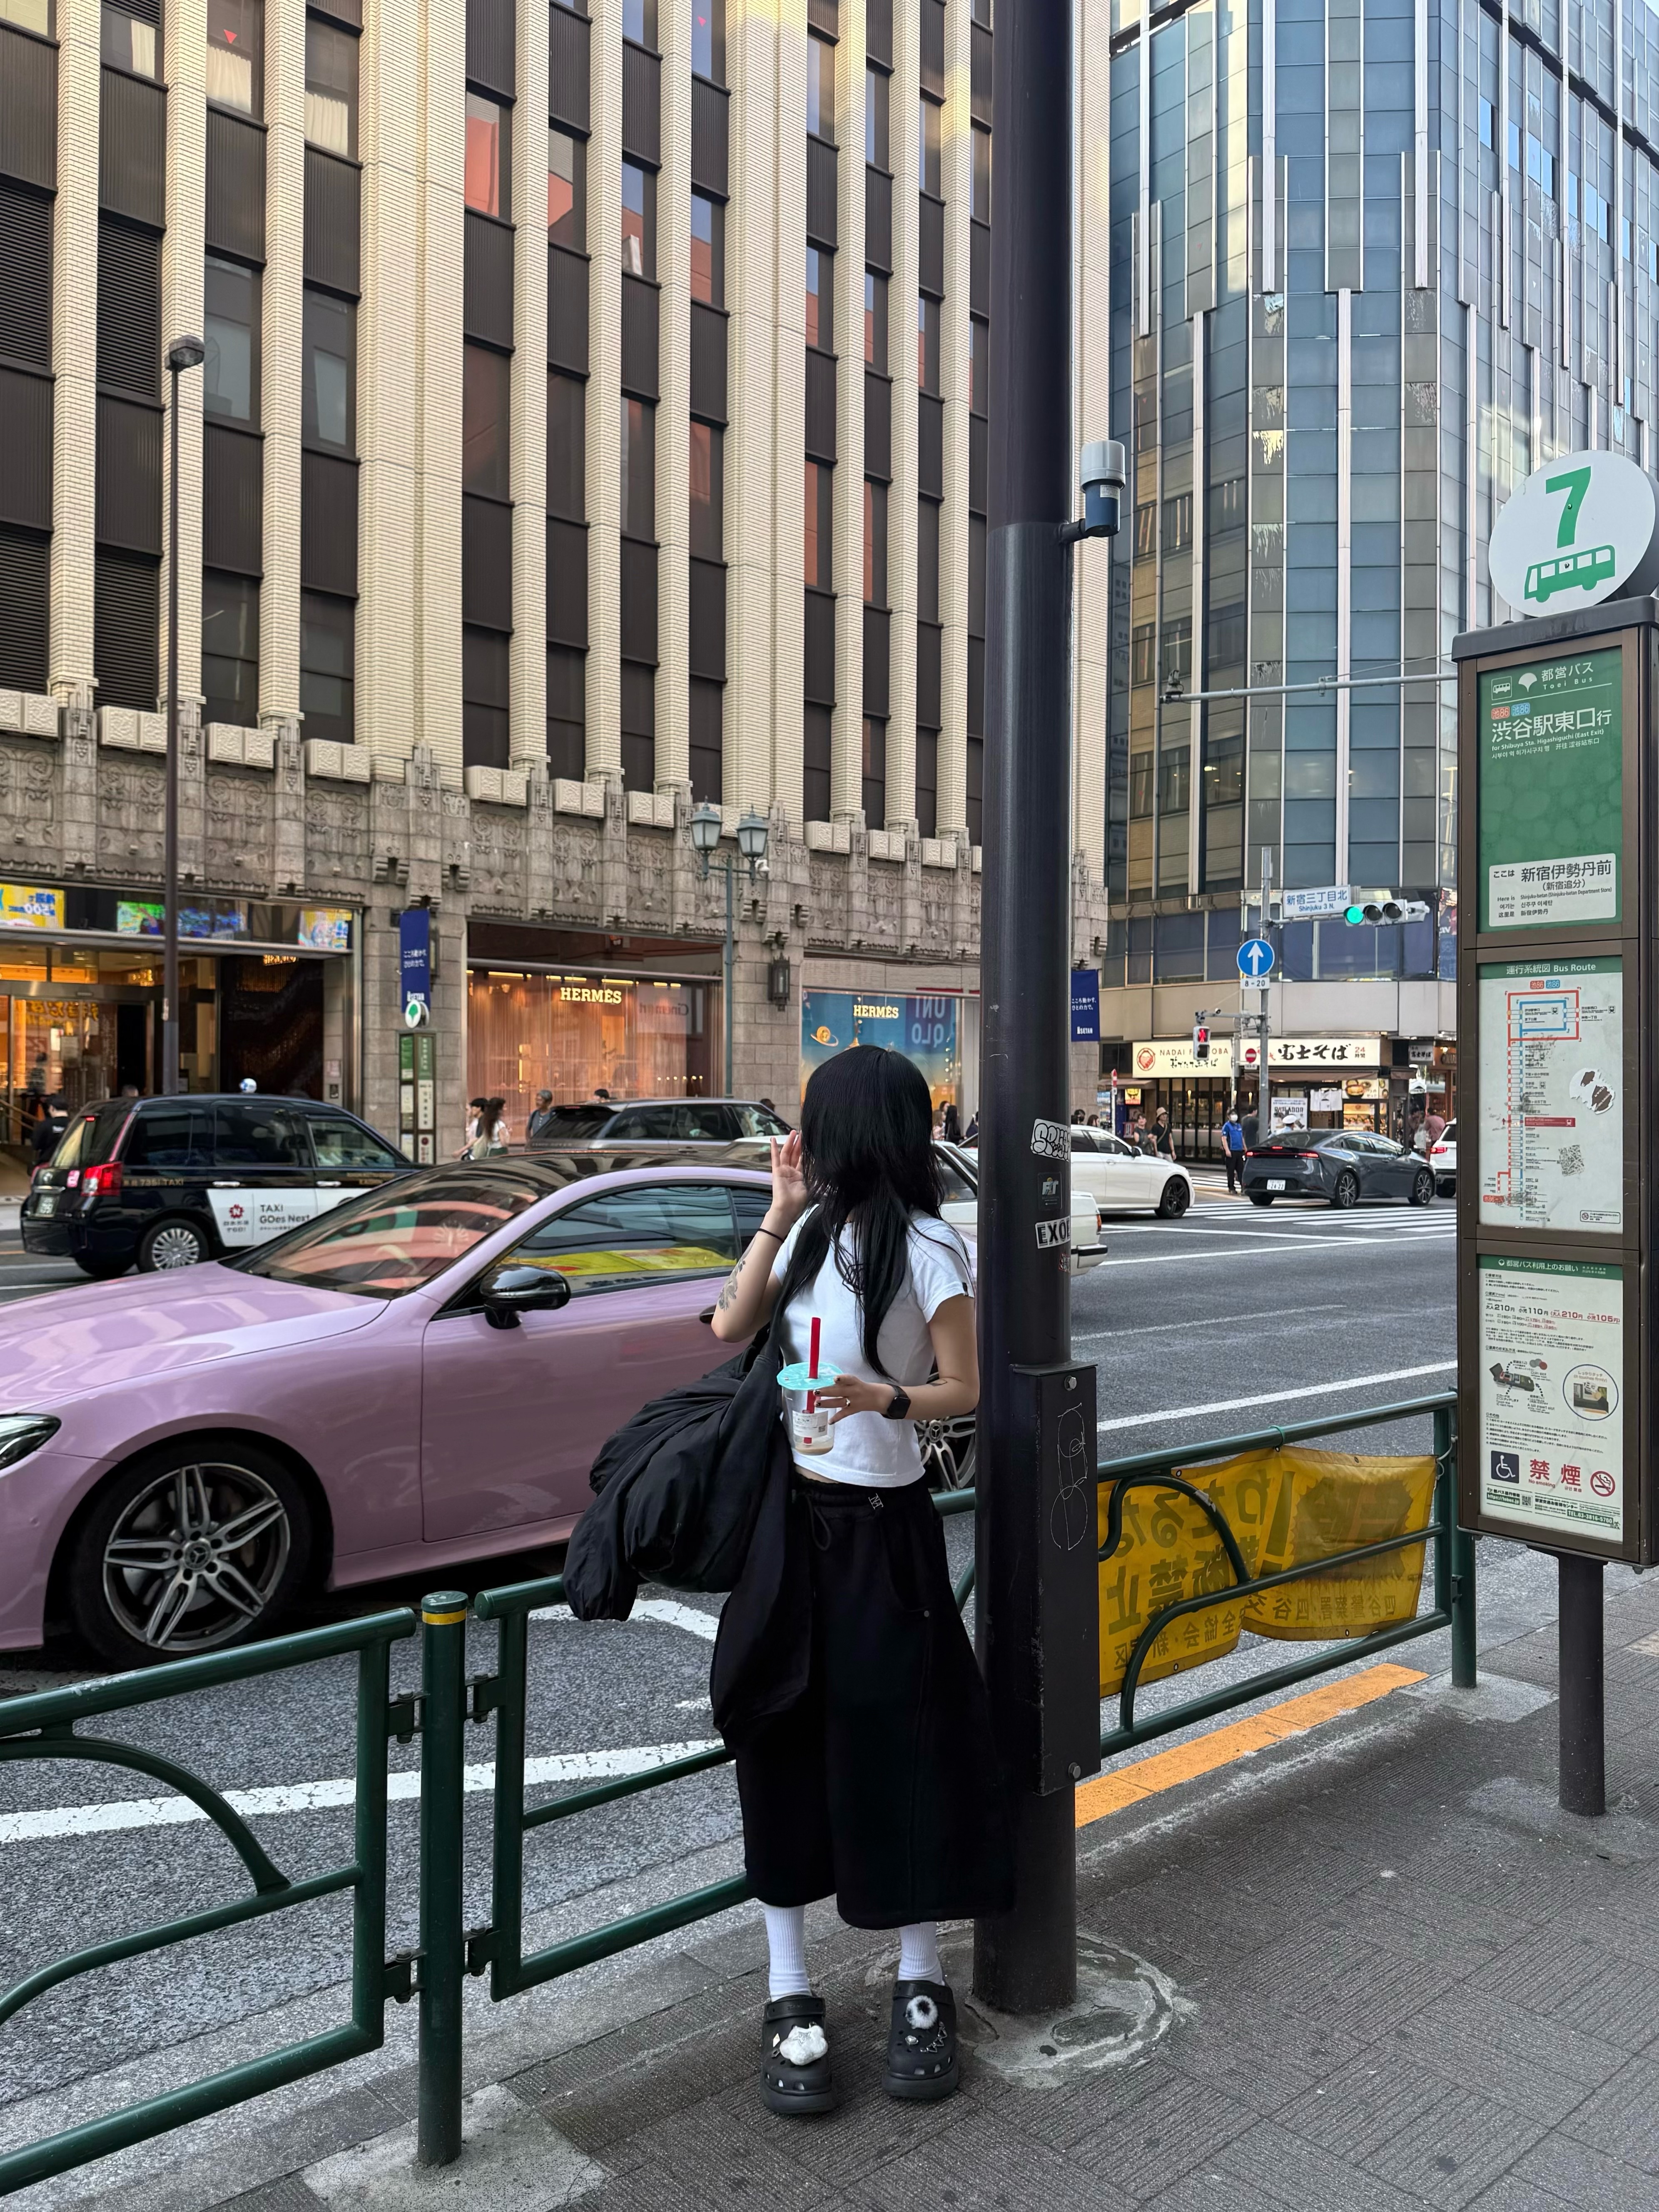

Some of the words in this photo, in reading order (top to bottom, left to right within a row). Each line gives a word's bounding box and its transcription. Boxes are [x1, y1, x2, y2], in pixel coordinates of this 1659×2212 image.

[1546, 466, 1591, 548] 7
[1542, 662, 1594, 682] 都営バス
[1543, 681, 1566, 690] Toei
[1492, 707, 1612, 742] 渋谷駅東口行
[1501, 742, 1523, 751] Shibuya
[1537, 734, 1574, 745] Higashiguchi
[1494, 869, 1515, 878] ここは
[1521, 860, 1612, 882] 新宿伊勢丹前
[1287, 890, 1348, 906] 新宿三丁目北
[1506, 964, 1550, 974] 運行系統図
[560, 987, 622, 1004] HERMÈS
[854, 1005, 899, 1019] HERMÈS
[1278, 1044, 1351, 1060] 富士そば
[162, 1178, 184, 1186] TAXI
[260, 1215, 286, 1223] GOes
[1530, 1459, 1581, 1487] 禁煙
[1536, 1480, 1555, 1489] smoking
